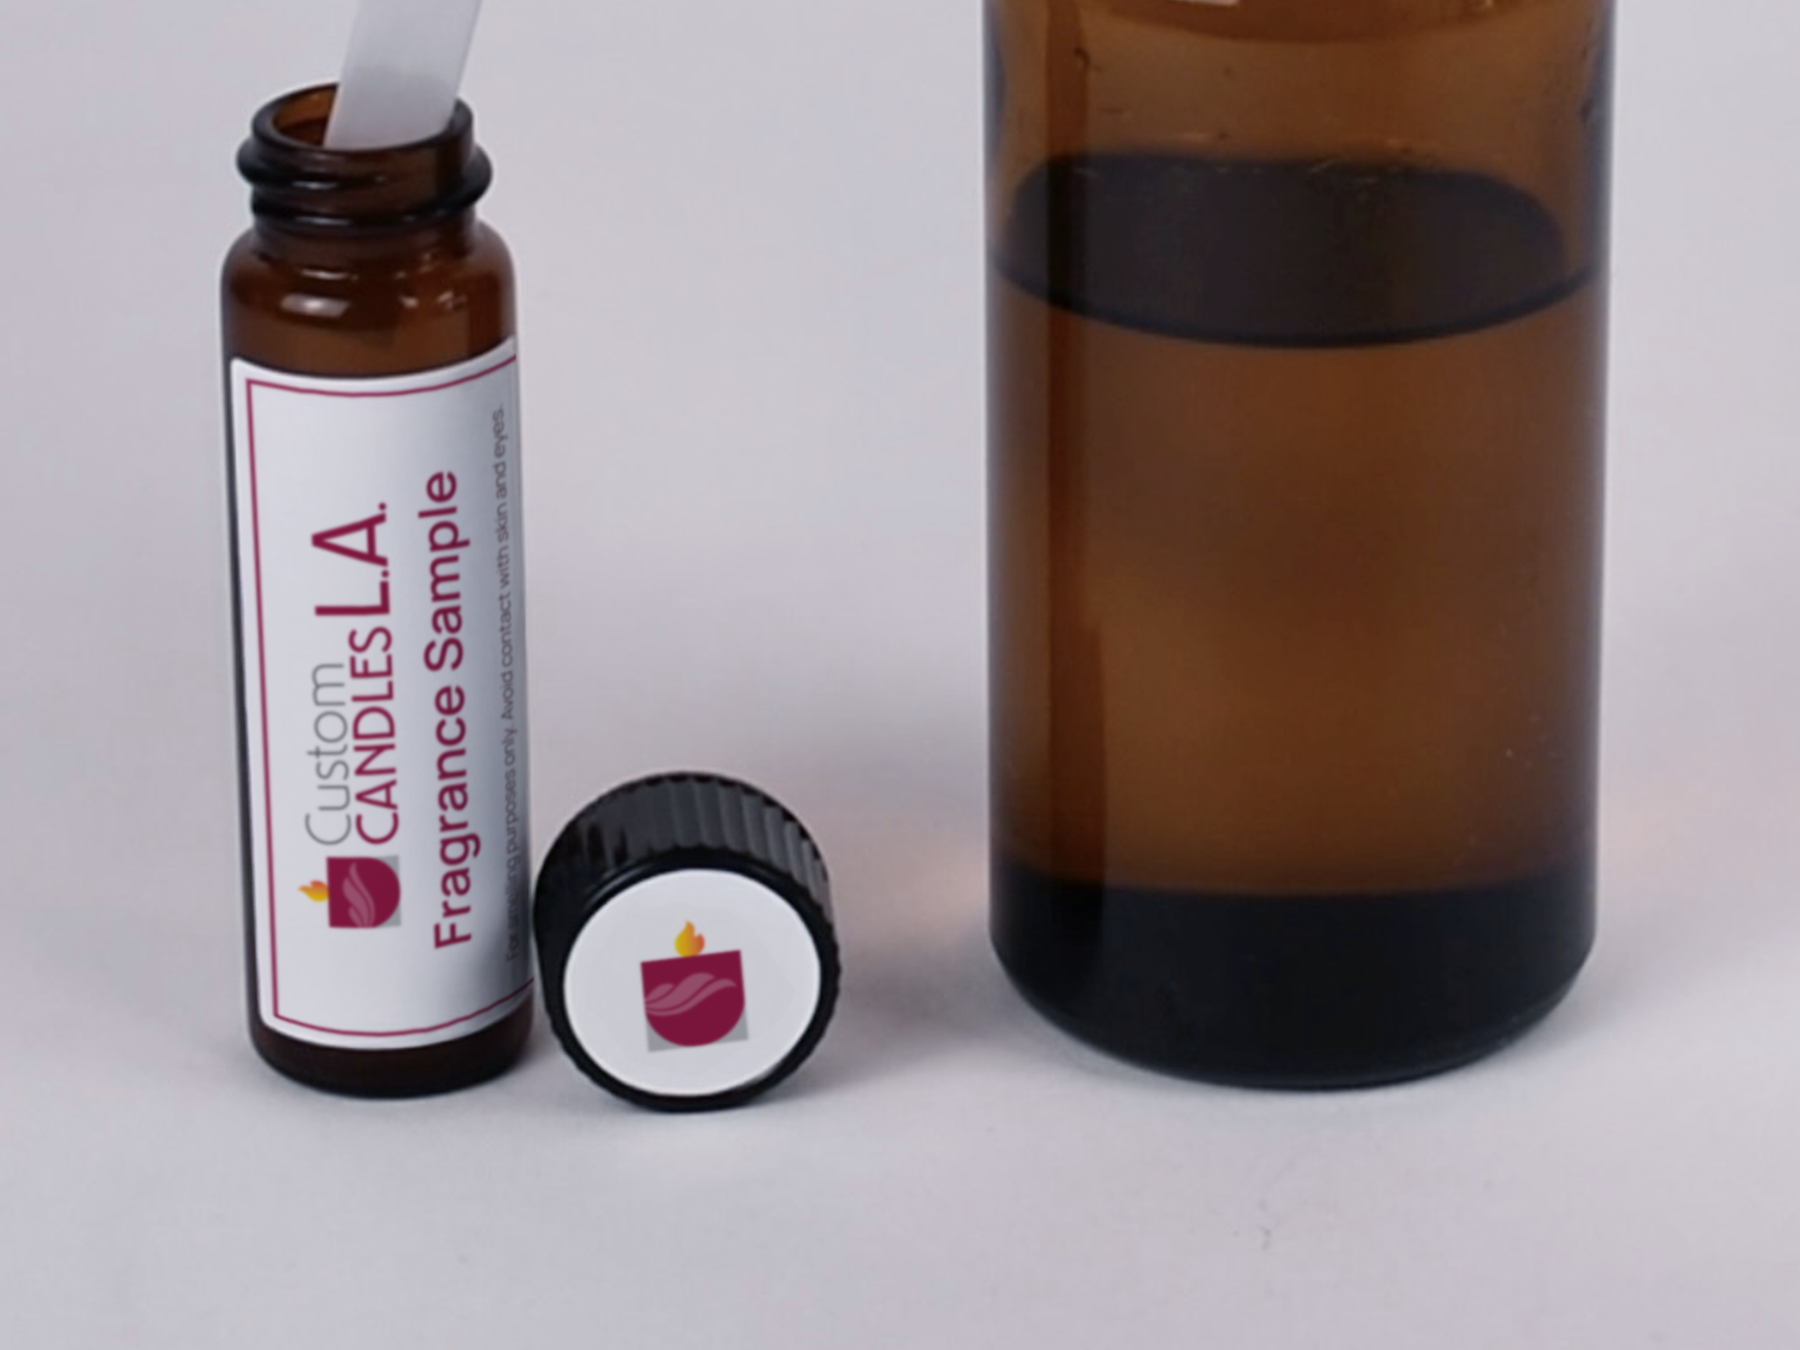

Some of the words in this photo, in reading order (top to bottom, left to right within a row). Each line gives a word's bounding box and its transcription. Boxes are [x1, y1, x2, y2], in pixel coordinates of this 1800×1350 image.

[490, 404, 510, 459] eyes.
[491, 460, 508, 500] and
[311, 501, 391, 617] L.A.
[493, 502, 510, 544] skin
[418, 471, 471, 672] Sample
[494, 545, 511, 590] with
[497, 593, 515, 669] contact
[498, 670, 515, 722] Avoid
[304, 663, 353, 845] Custom
[348, 626, 400, 846] CANDLES
[500, 723, 518, 767] only.
[434, 686, 480, 949] Fragrance
[502, 768, 521, 854] purposes
